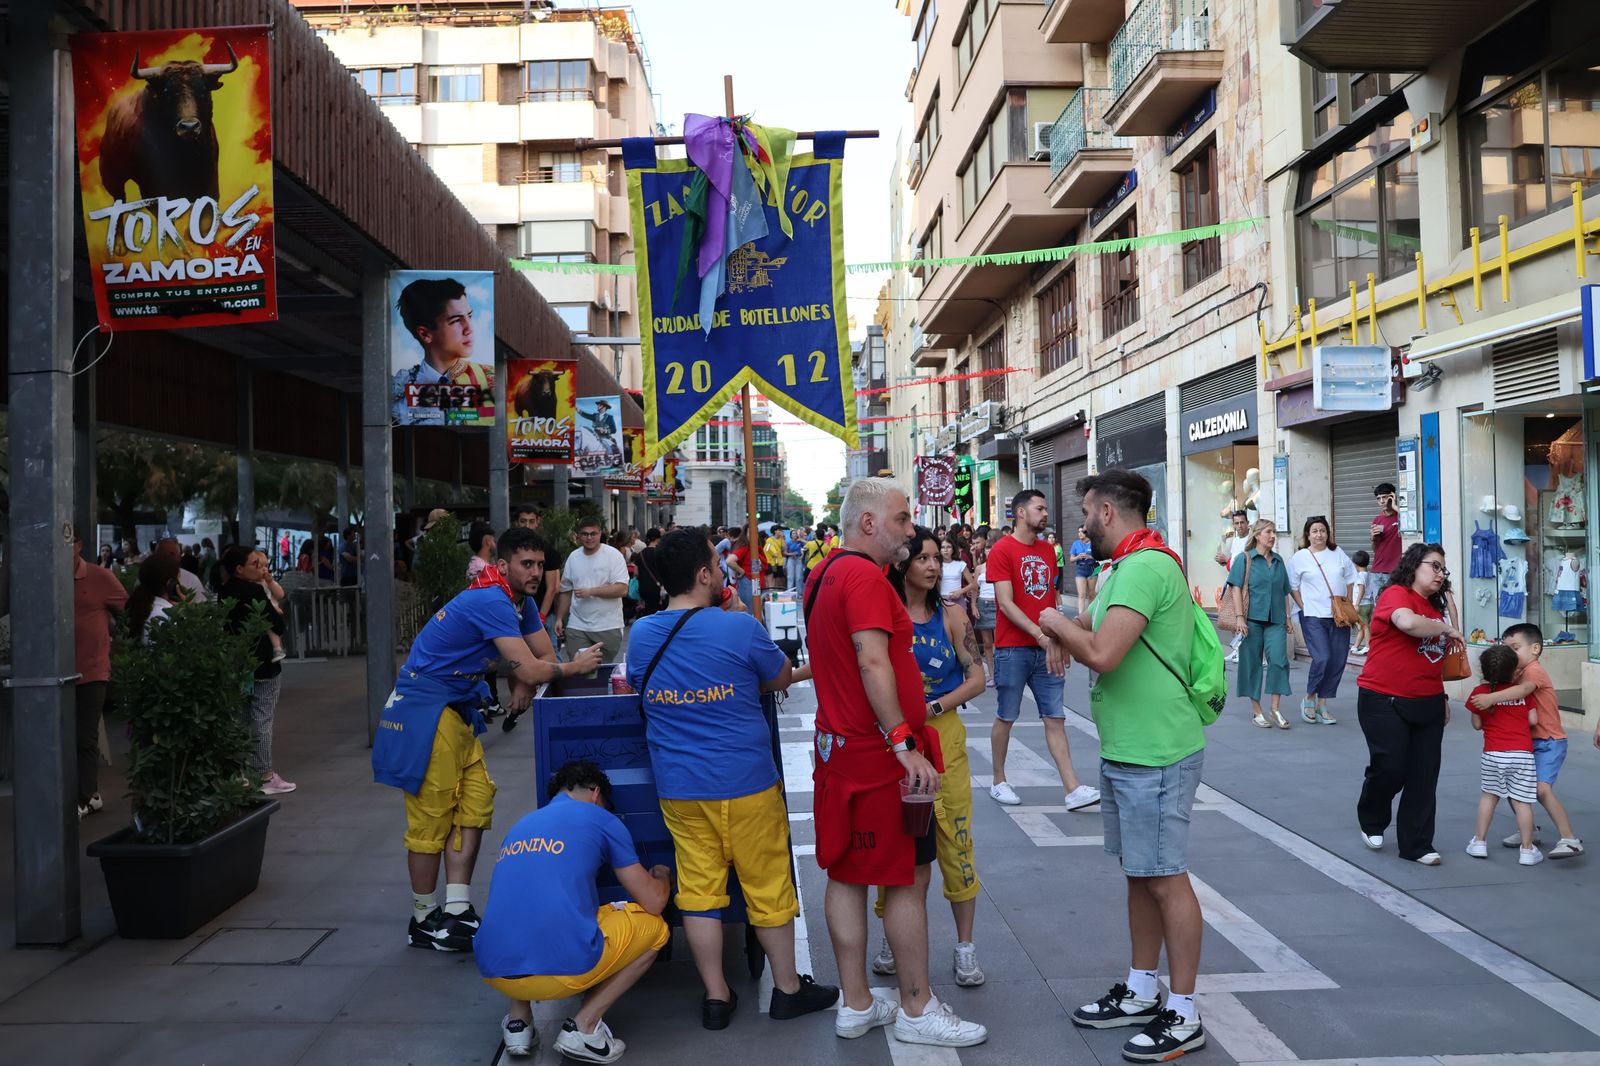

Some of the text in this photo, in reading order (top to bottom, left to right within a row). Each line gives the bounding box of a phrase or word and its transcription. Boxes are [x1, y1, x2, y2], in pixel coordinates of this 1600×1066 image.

[89, 184, 260, 257] TOROS
[245, 236, 262, 251] EN
[102, 253, 264, 284] ZAMORA
[114, 284, 259, 300] COMPRA TUS ENTRADAS
[653, 303, 831, 334] CIUDAD DE BOTELLONES
[664, 350, 830, 395] 20 12
[510, 415, 571, 436] TOROS
[1189, 408, 1248, 442] CALZEDONIA
[511, 438, 571, 447] ZAMORA
[646, 683, 735, 705] CARLOSMH
